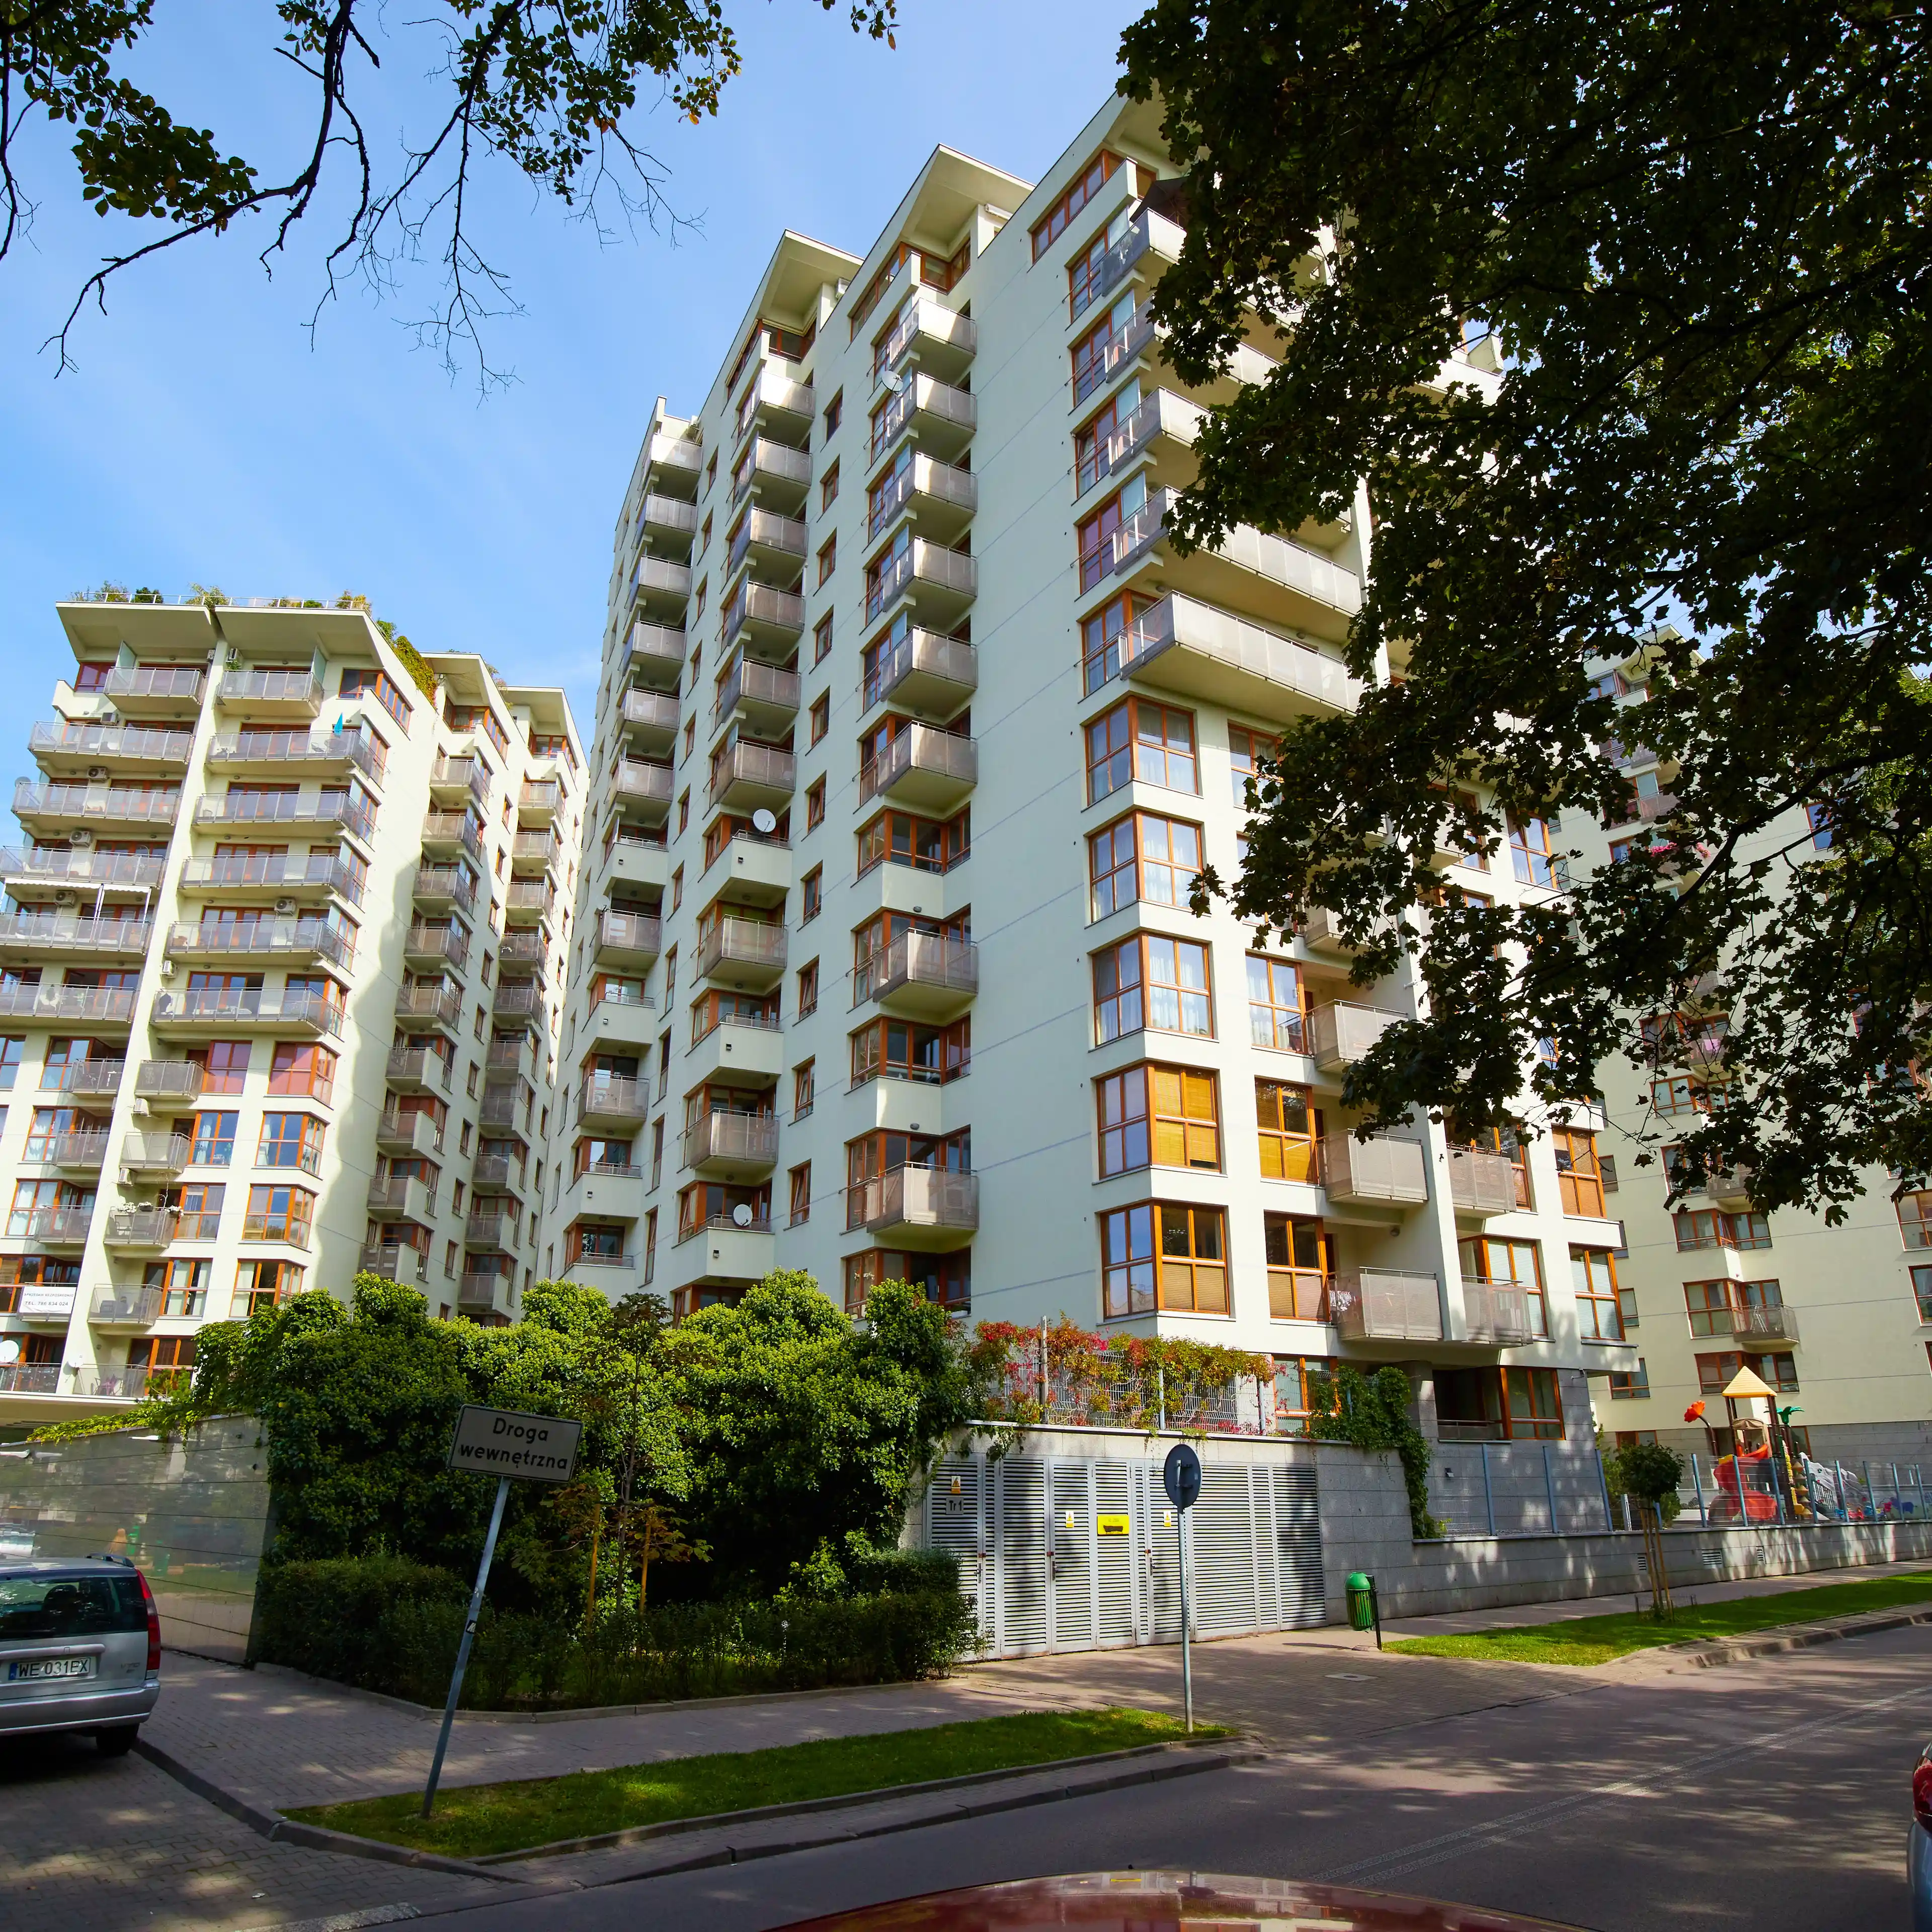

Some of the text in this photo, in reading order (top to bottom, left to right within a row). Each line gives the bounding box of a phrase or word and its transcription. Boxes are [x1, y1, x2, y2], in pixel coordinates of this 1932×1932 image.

[493, 1417, 549, 1444] Droga
[460, 1443, 568, 1469] wewnętrzna
[949, 1500, 962, 1511] Tr 1
[19, 1659, 88, 1677] WE 031EX
